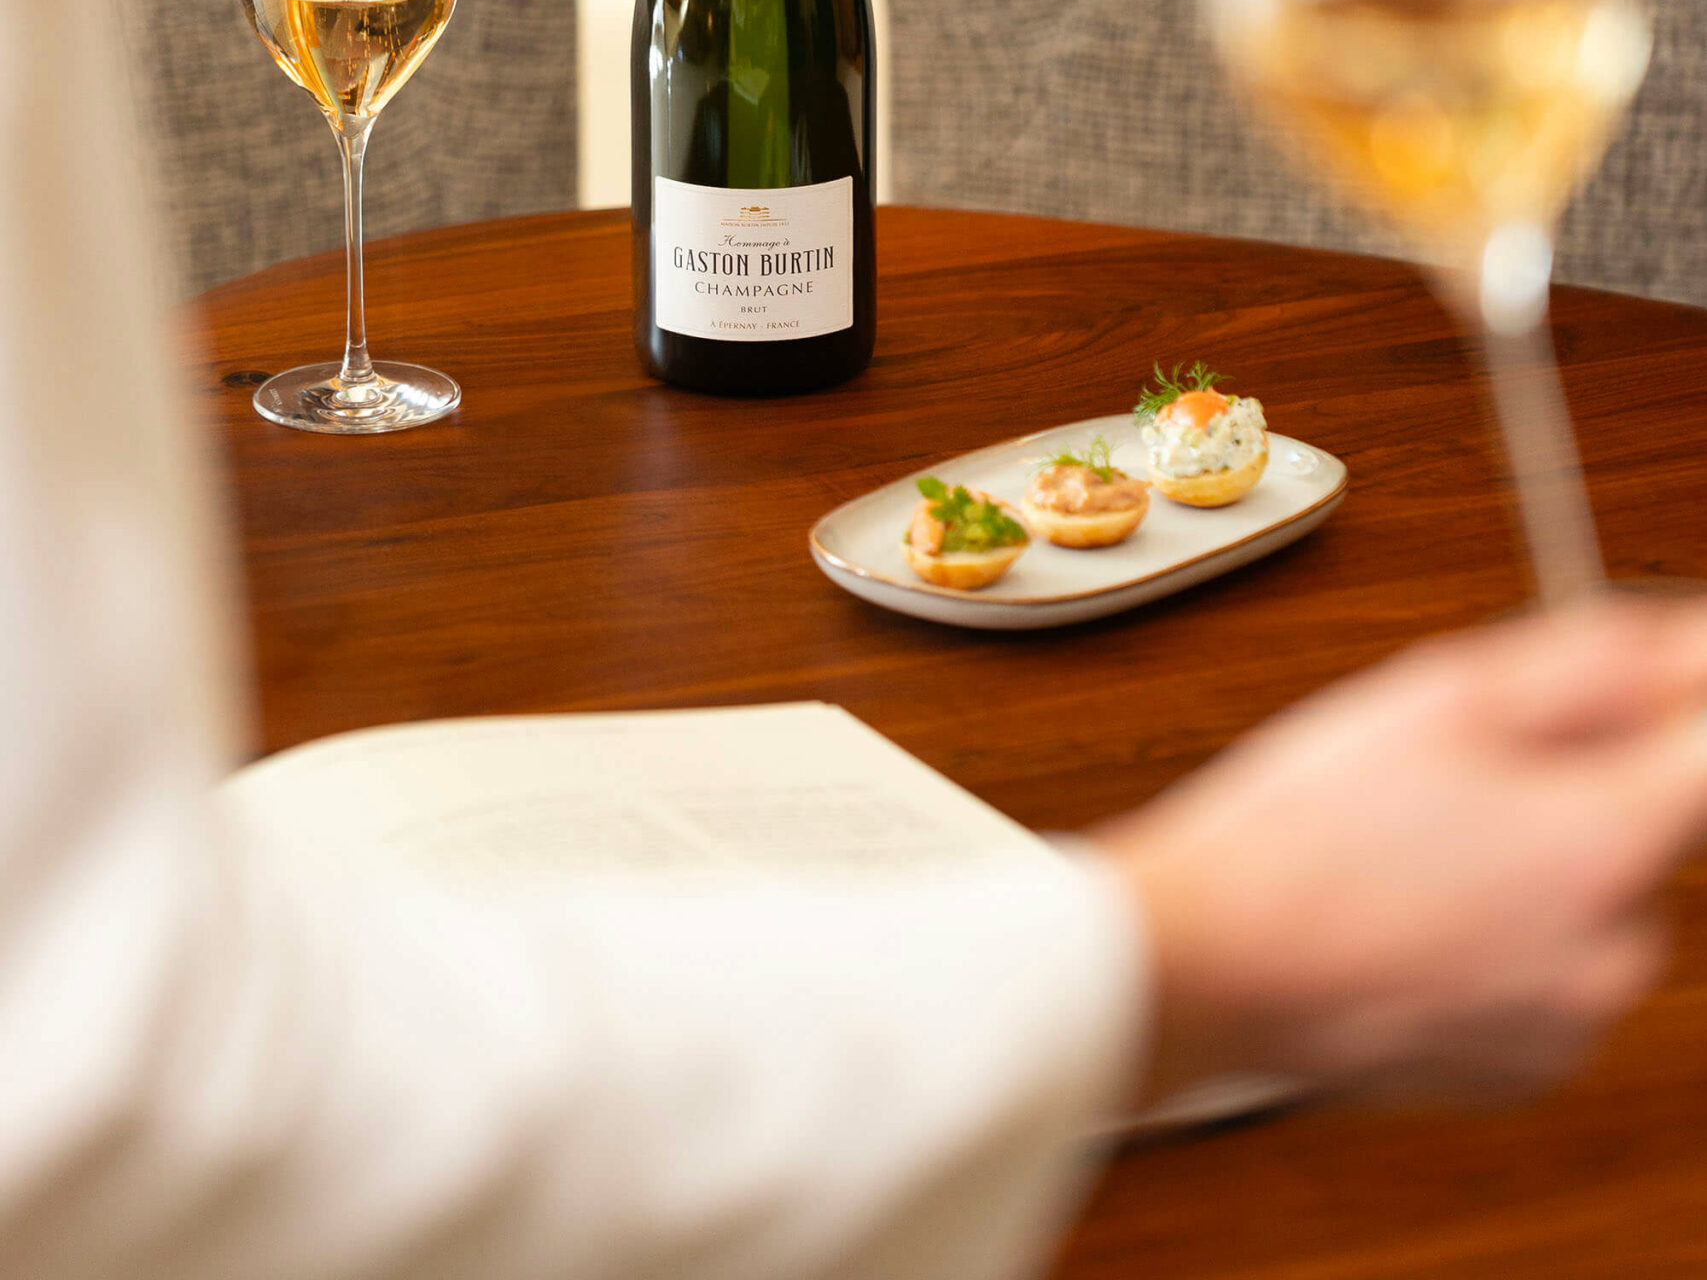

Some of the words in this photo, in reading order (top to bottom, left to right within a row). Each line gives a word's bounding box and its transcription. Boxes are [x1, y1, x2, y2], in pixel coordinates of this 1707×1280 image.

[718, 234, 780, 251] Hommage
[674, 246, 749, 276] GASTON
[760, 246, 834, 276] BURTIN
[694, 281, 814, 297] CHAMPAGNE
[766, 320, 800, 329] FRANCE
